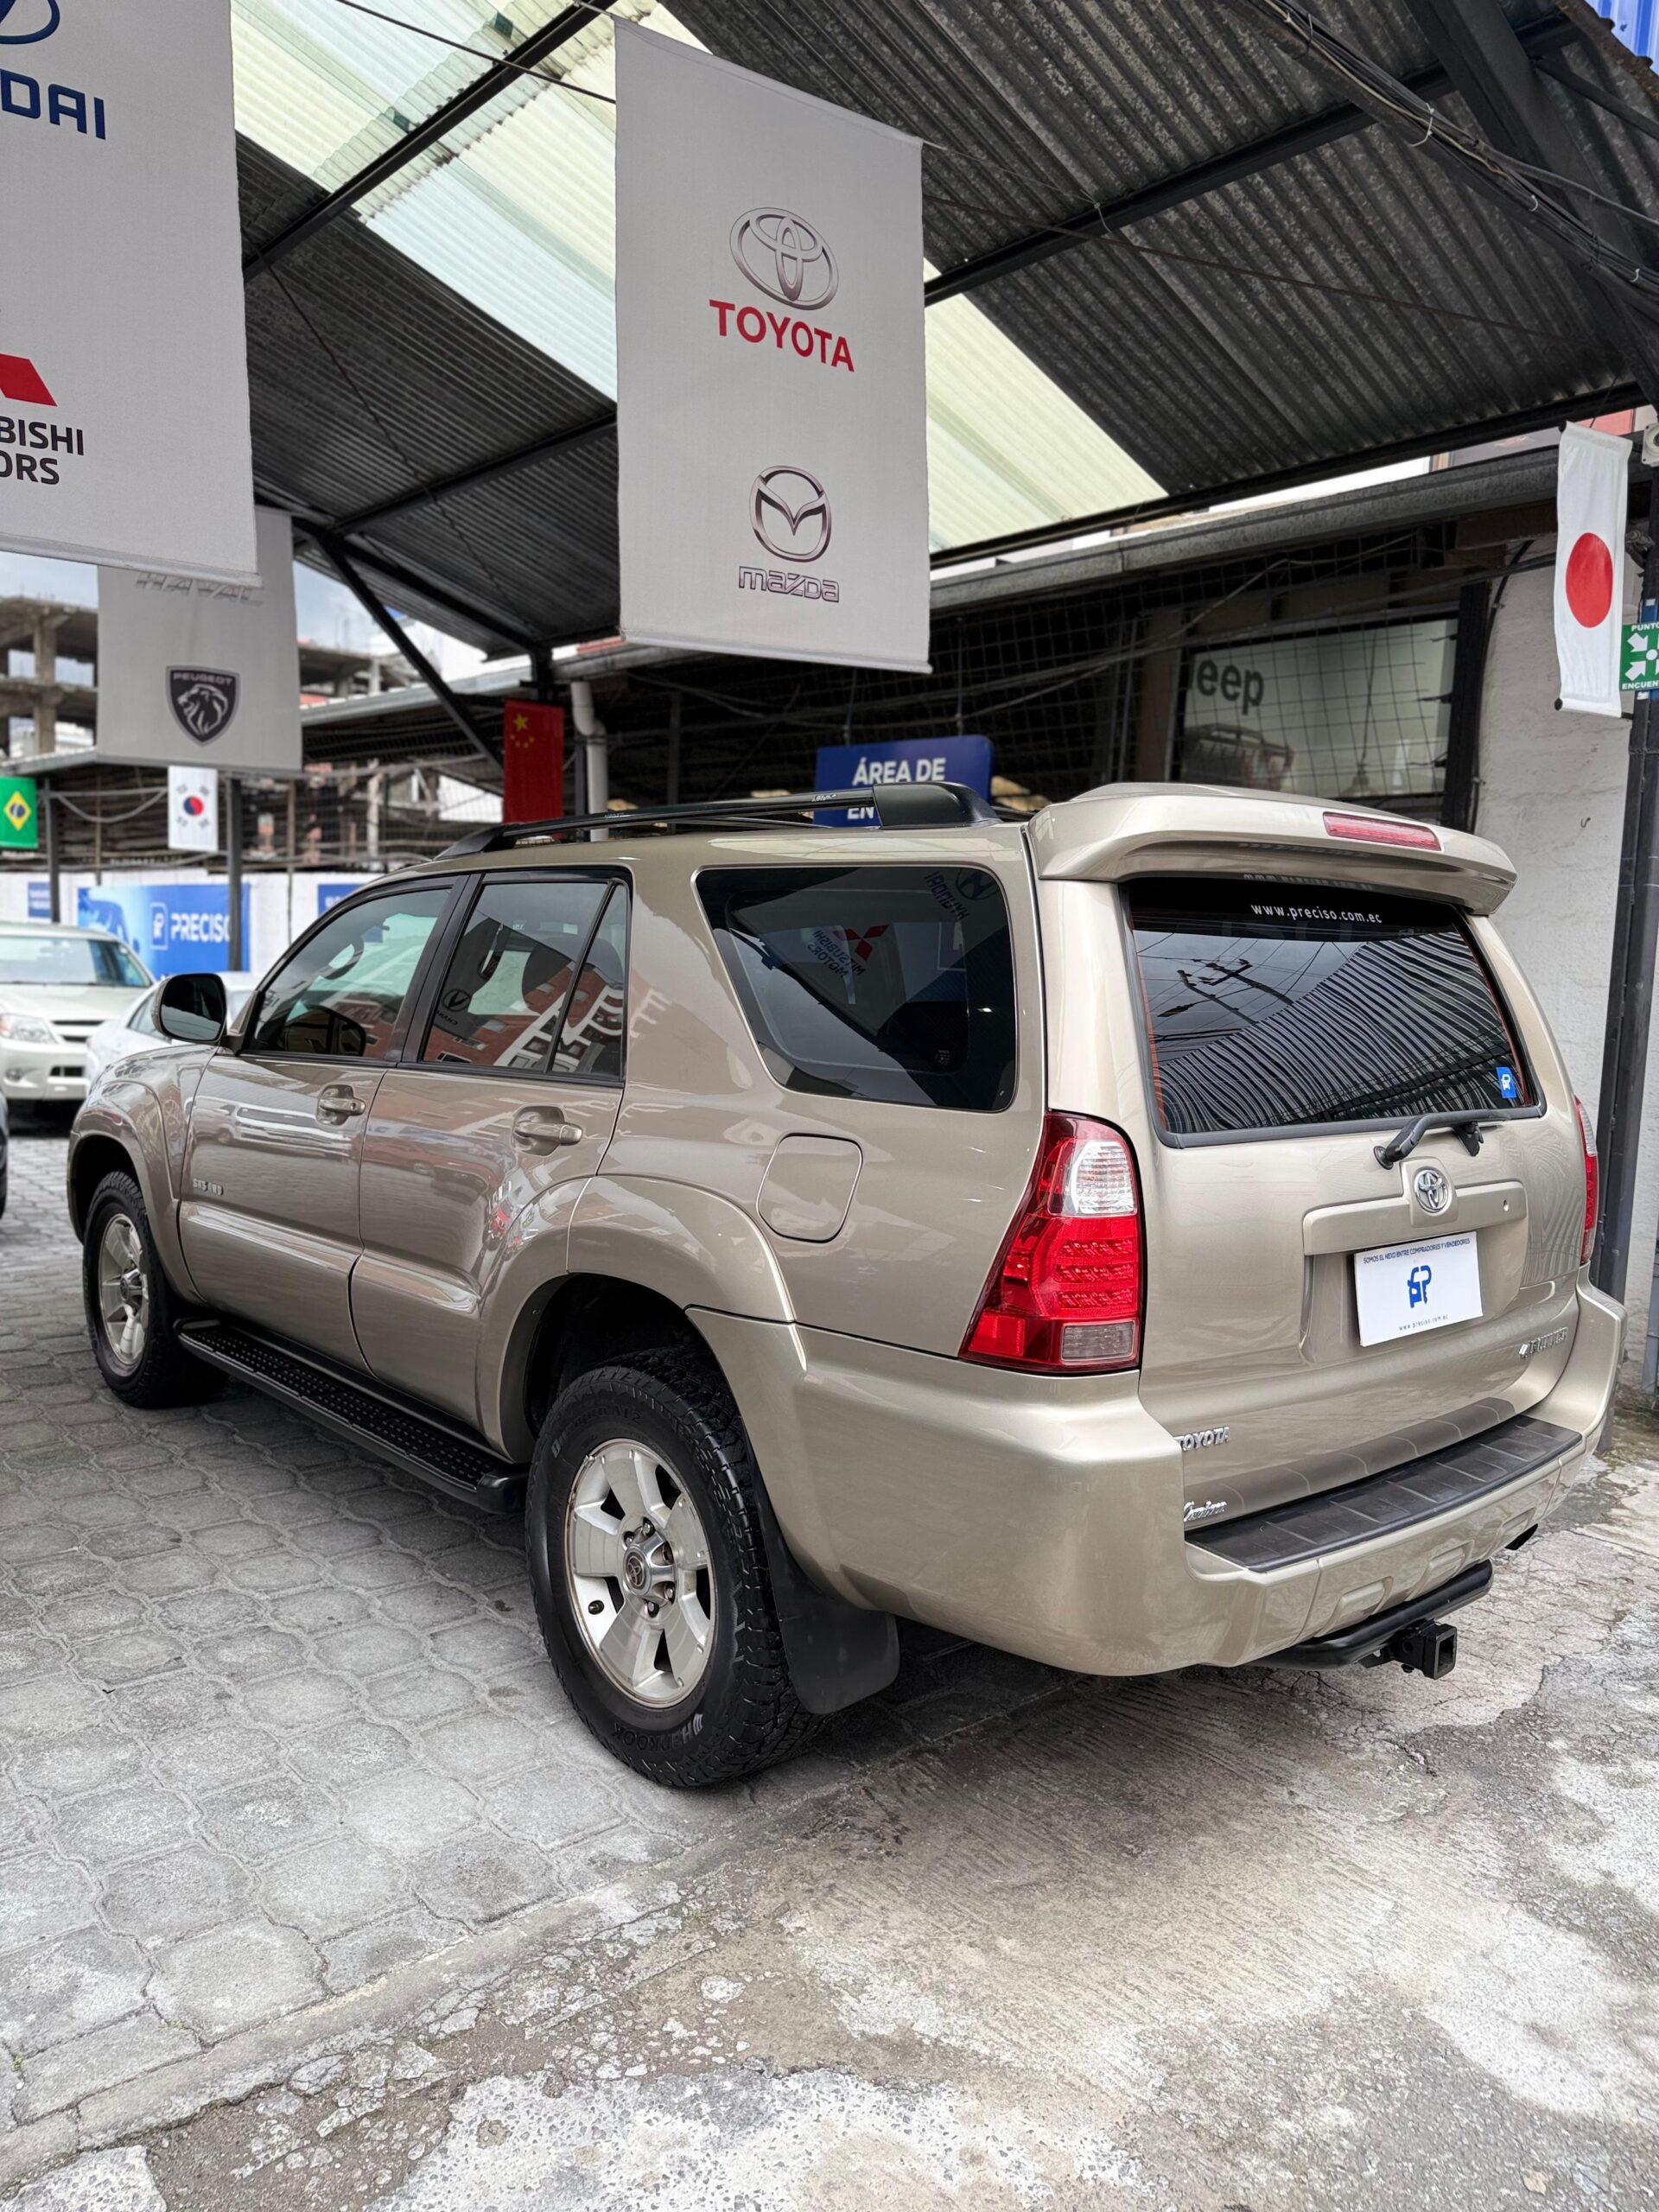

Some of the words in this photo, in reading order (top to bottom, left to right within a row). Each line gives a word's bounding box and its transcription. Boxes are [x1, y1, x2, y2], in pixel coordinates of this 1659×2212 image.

[709, 299, 855, 372] TOYOTA
[173, 671, 232, 685] PEUGEOT
[852, 756, 912, 786] ÁREA
[916, 757, 946, 782] DE
[1251, 904, 1382, 924] www.preciso.com.ec
[1363, 1255, 1379, 1264] SOMOS
